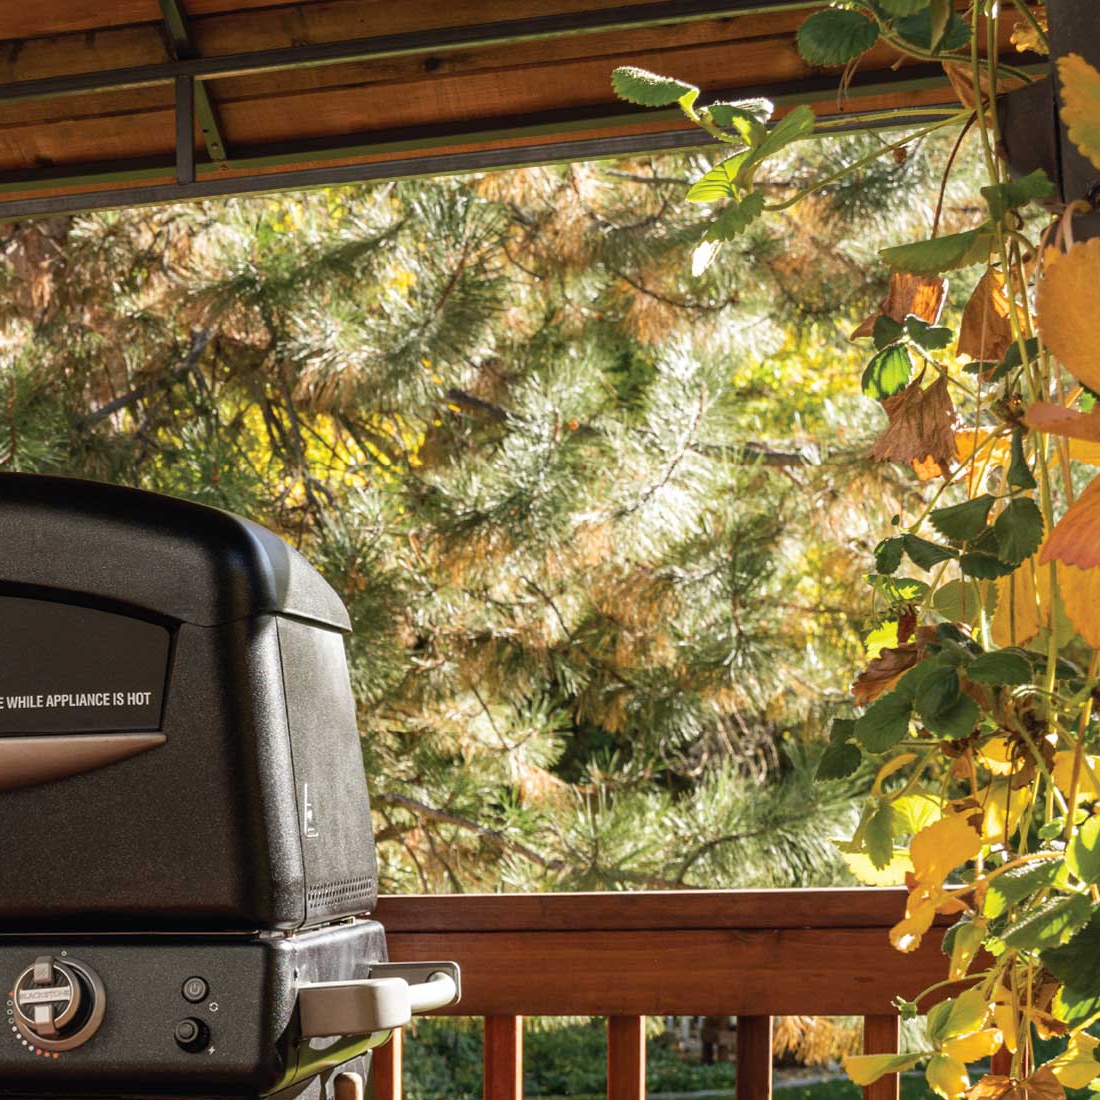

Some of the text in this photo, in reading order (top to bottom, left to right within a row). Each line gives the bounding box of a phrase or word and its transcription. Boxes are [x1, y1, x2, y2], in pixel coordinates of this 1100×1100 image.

[6, 694, 44, 709] WHILE
[45, 692, 111, 708] APPLIANCE
[112, 692, 125, 706] IS
[127, 691, 152, 706] HOT
